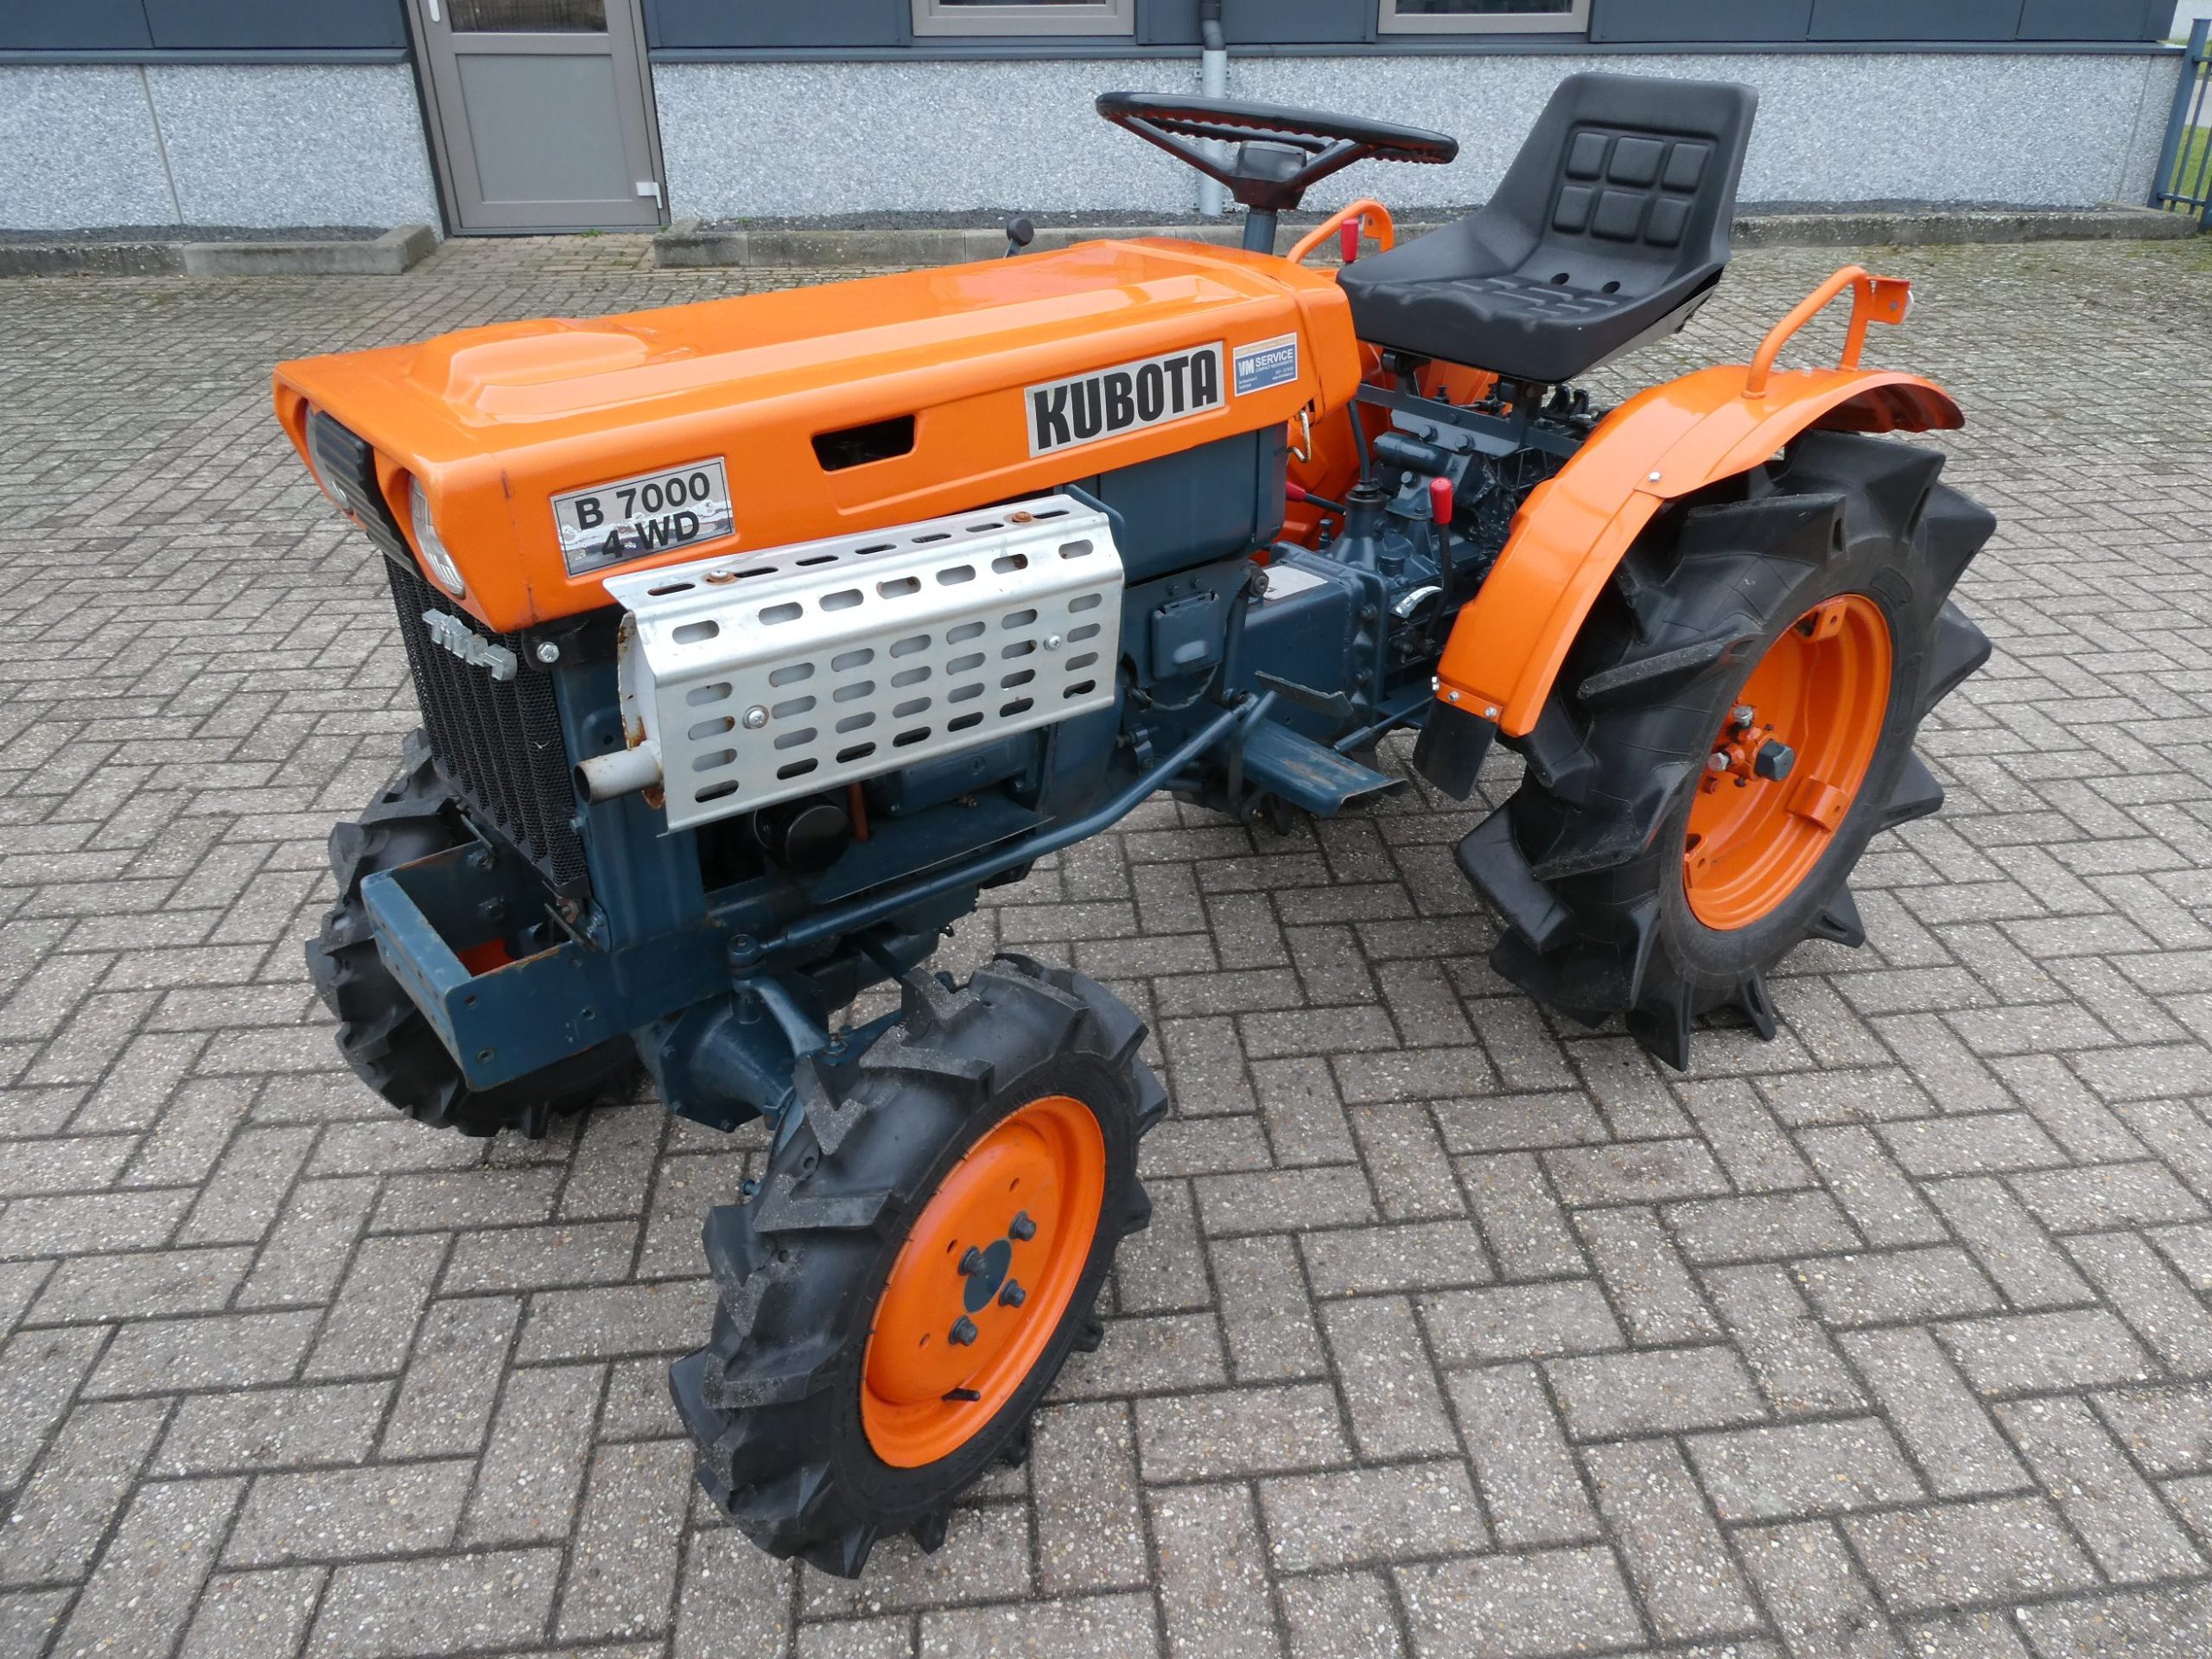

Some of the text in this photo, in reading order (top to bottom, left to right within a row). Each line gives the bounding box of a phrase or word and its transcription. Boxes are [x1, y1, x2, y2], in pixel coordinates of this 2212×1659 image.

[1255, 349, 1294, 367] SERVICE
[1033, 350, 1218, 450] KUBOTA
[575, 472, 710, 531] B 7000
